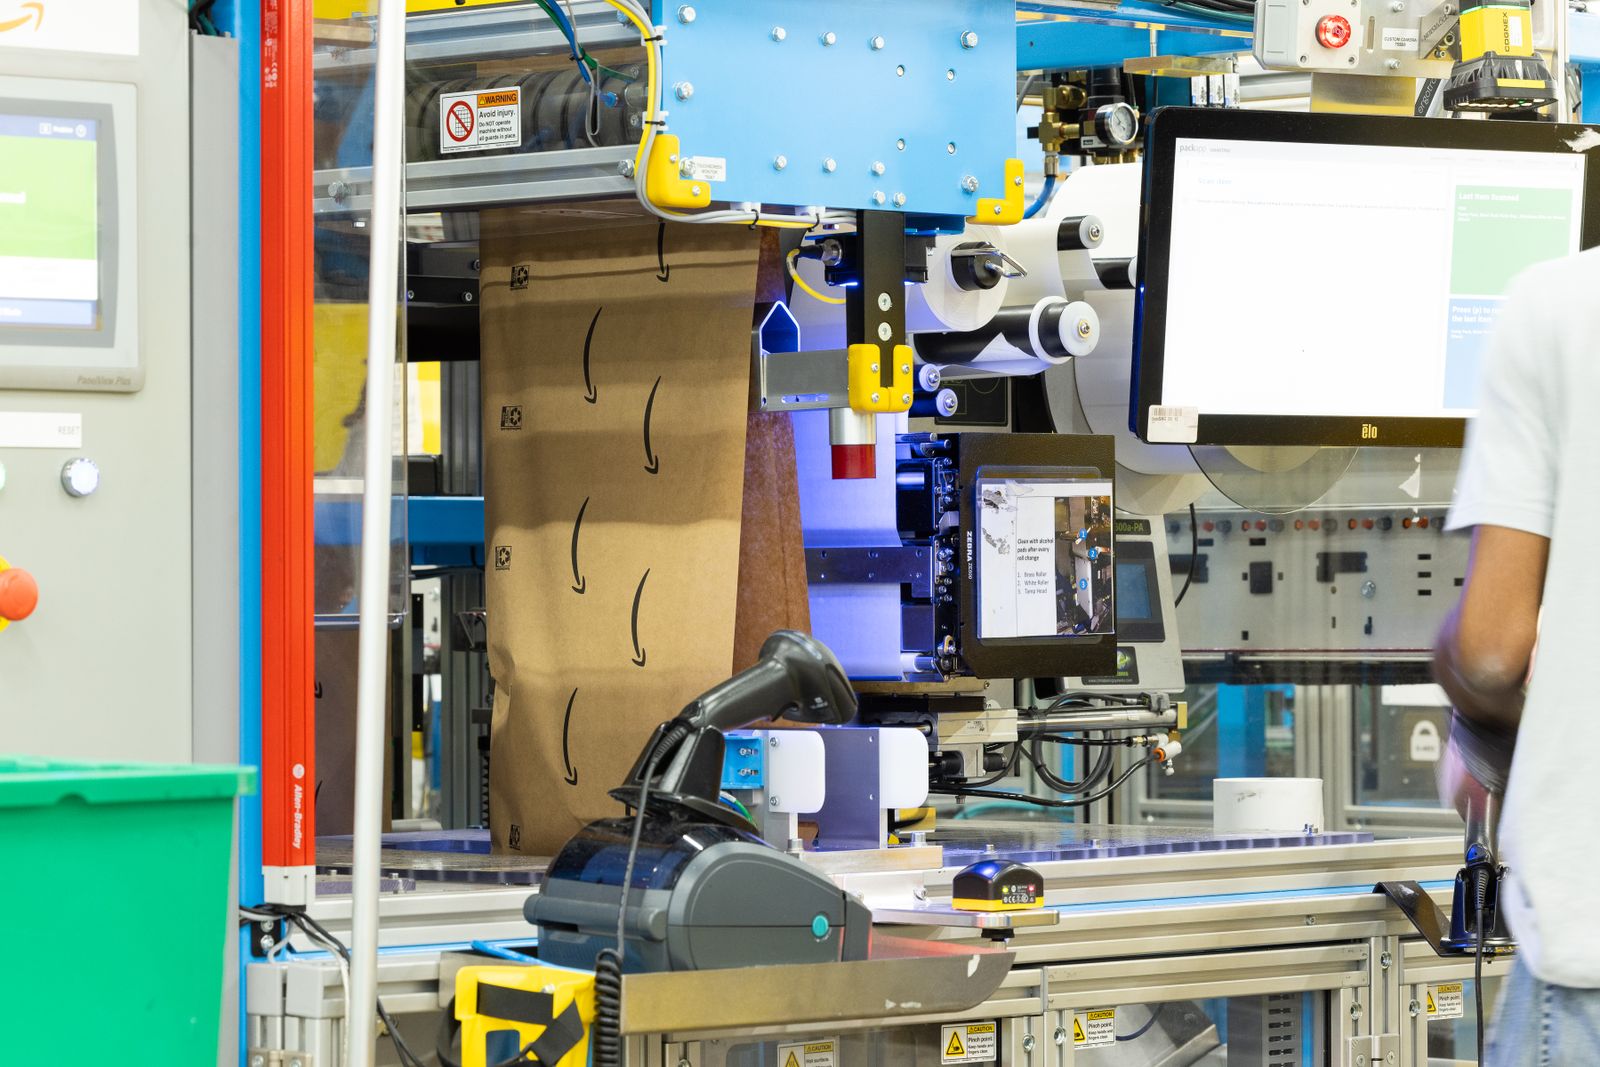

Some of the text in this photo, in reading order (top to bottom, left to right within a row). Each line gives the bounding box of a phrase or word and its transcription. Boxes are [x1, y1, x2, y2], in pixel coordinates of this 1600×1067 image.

[485, 94, 517, 104] WARNING
[479, 108, 516, 118] Avoid injury.
[1459, 192, 1473, 200] Last
[116, 378, 132, 386] Plus
[58, 426, 80, 435] RESET
[292, 783, 302, 850] Allen-Bradley
